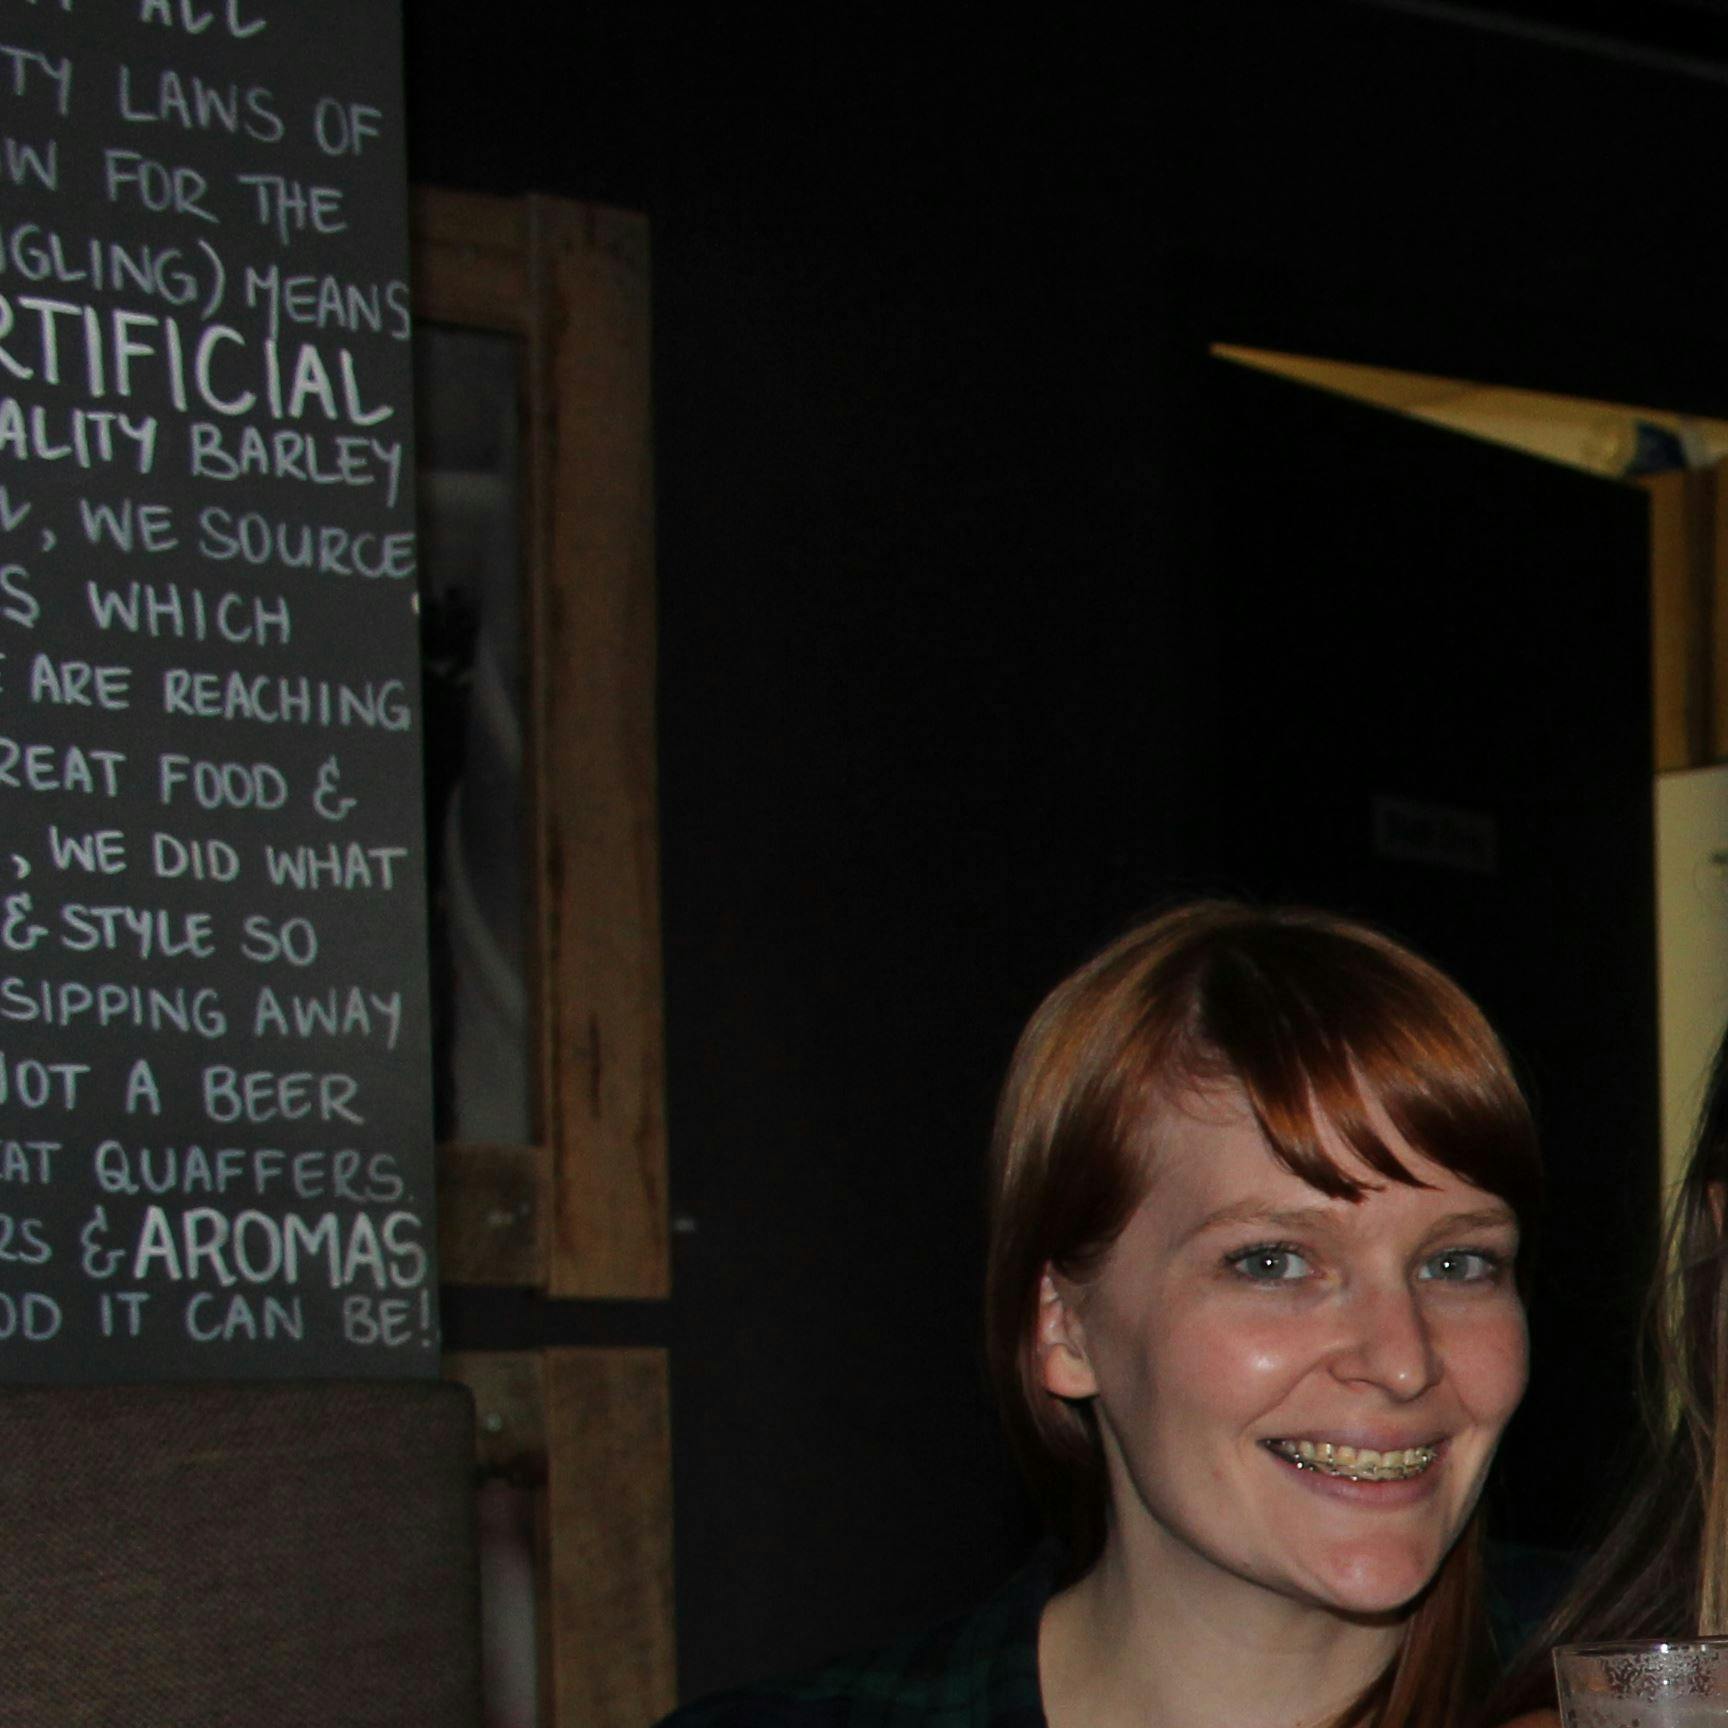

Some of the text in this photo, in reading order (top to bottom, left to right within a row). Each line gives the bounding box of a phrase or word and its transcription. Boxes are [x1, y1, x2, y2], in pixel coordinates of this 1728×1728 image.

[119, 65, 285, 142] LAWS
[314, 98, 383, 156] OF
[105, 149, 219, 223] FOR
[238, 174, 347, 245] THE
[0, 223, 410, 341] GLING) MEANS
[191, 422, 400, 508] BARLEY
[81, 498, 178, 552] WE
[199, 507, 416, 578] SOURCE
[87, 580, 291, 645] WHICH
[31, 653, 410, 731] ARE REACHING
[160, 754, 288, 810] FOOD
[313, 755, 356, 819] &
[49, 825, 407, 891] WE DID WHAT
[2, 892, 318, 966] & STYLE SO
[0, 976, 402, 1050] SIPPING AWAY
[0, 1051, 364, 1125] OT A BEER
[0, 1138, 62, 1185] AT
[80, 1205, 126, 1279] &
[133, 1203, 428, 1290] AROMAS
[101, 1292, 150, 1337] IT
[185, 1292, 304, 1341] CAN
[343, 1289, 432, 1348] BE!
